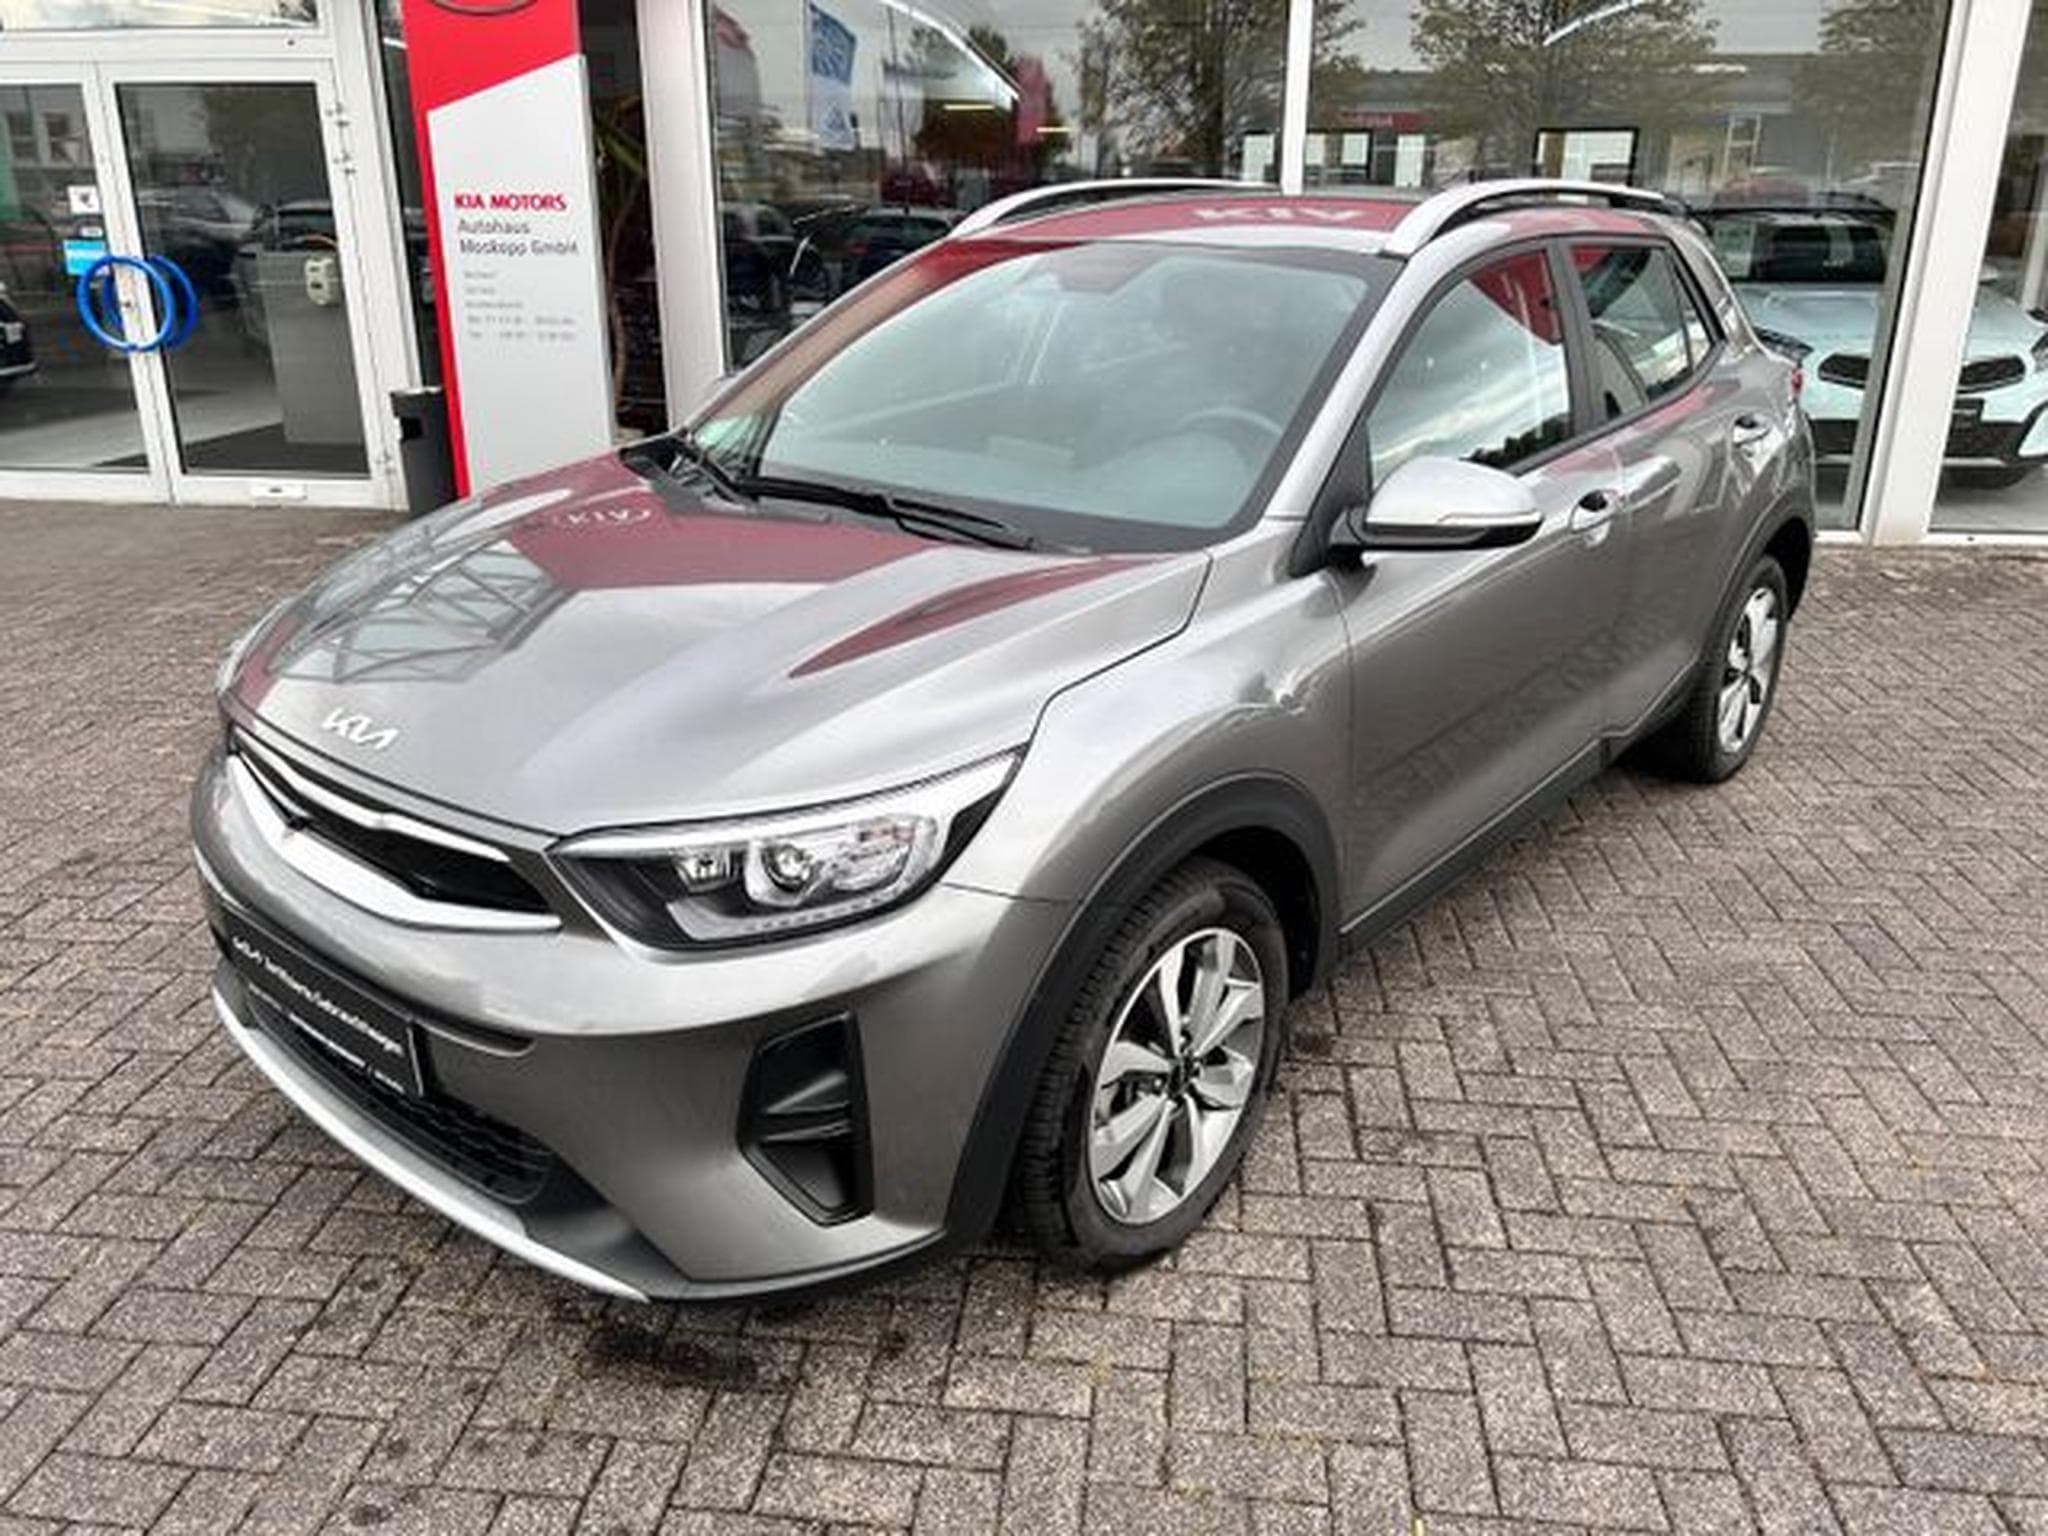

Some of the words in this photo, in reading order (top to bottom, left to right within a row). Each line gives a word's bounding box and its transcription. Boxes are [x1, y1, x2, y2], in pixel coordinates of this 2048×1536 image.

[454, 194, 485, 209] KIA
[490, 194, 567, 211] MOTORS
[458, 218, 531, 235] Autohaus
[531, 240, 578, 255] GmbH
